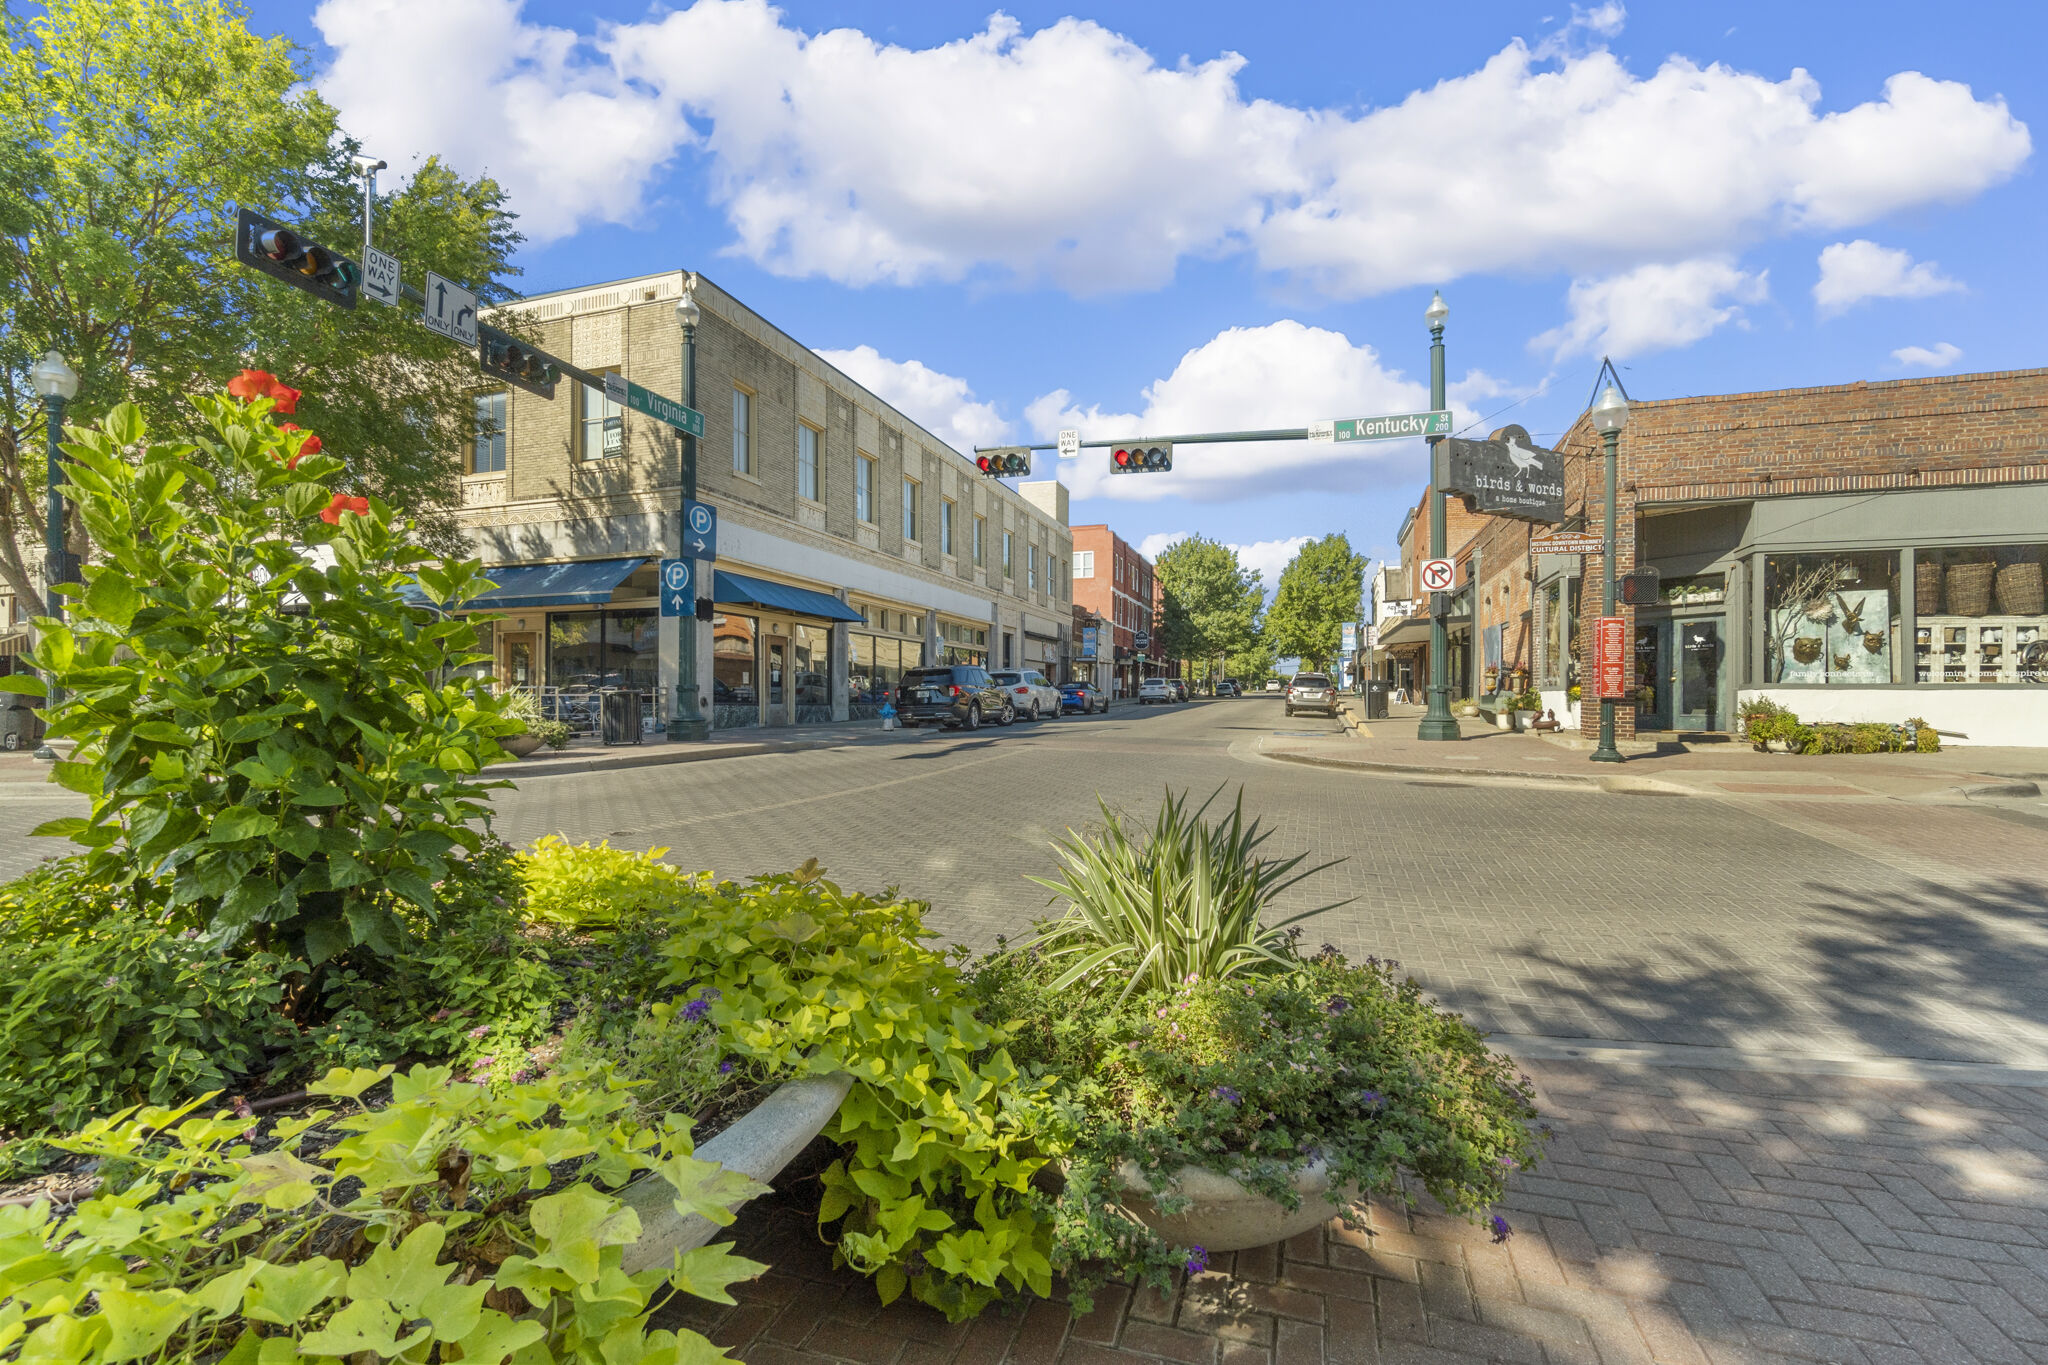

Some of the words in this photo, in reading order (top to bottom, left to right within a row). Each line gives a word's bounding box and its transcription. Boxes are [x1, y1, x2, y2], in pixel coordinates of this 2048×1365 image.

[369, 252, 395, 273] ONE
[368, 265, 395, 285] WAY
[428, 316, 450, 331] ONLY
[454, 326, 474, 341] ONLY
[647, 391, 687, 424] Virginia
[1060, 431, 1076, 439] ONE
[1338, 430, 1351, 440] 100
[1356, 415, 1429, 436] Kentucky
[1440, 414, 1449, 422] St
[1435, 423, 1449, 432] 200
[1060, 439, 1076, 447] WAY
[1475, 474, 1511, 491] birds
[1515, 480, 1523, 492] &
[1528, 483, 1563, 497] words
[1501, 494, 1517, 504] home
[1518, 496, 1546, 507] boutique
[696, 510, 707, 528] P
[1569, 544, 1602, 552] DISTRICT
[672, 567, 684, 585] P
